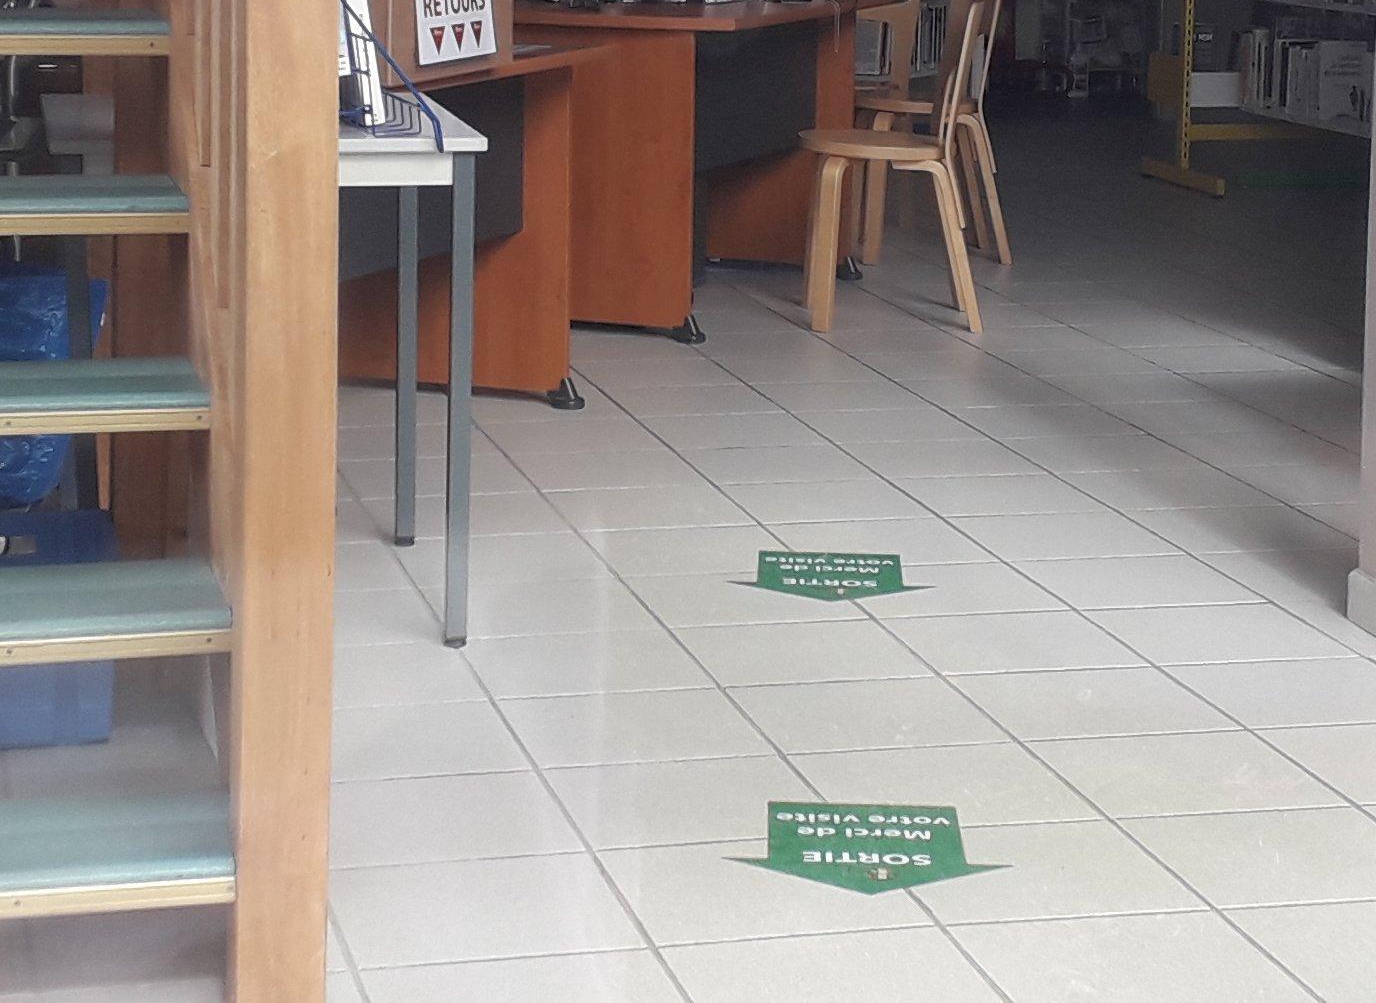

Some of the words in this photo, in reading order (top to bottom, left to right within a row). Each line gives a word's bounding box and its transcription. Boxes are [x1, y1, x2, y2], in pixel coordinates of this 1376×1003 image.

[764, 555, 826, 564] visite
[833, 557, 894, 566] votre
[779, 563, 809, 572] de
[815, 564, 880, 574] Merci
[782, 577, 878, 587] SORTIE
[775, 810, 861, 824] visite
[867, 814, 951, 826] votre
[796, 825, 836, 838] de
[845, 826, 931, 841] Merci
[802, 850, 933, 867] SORTIE
